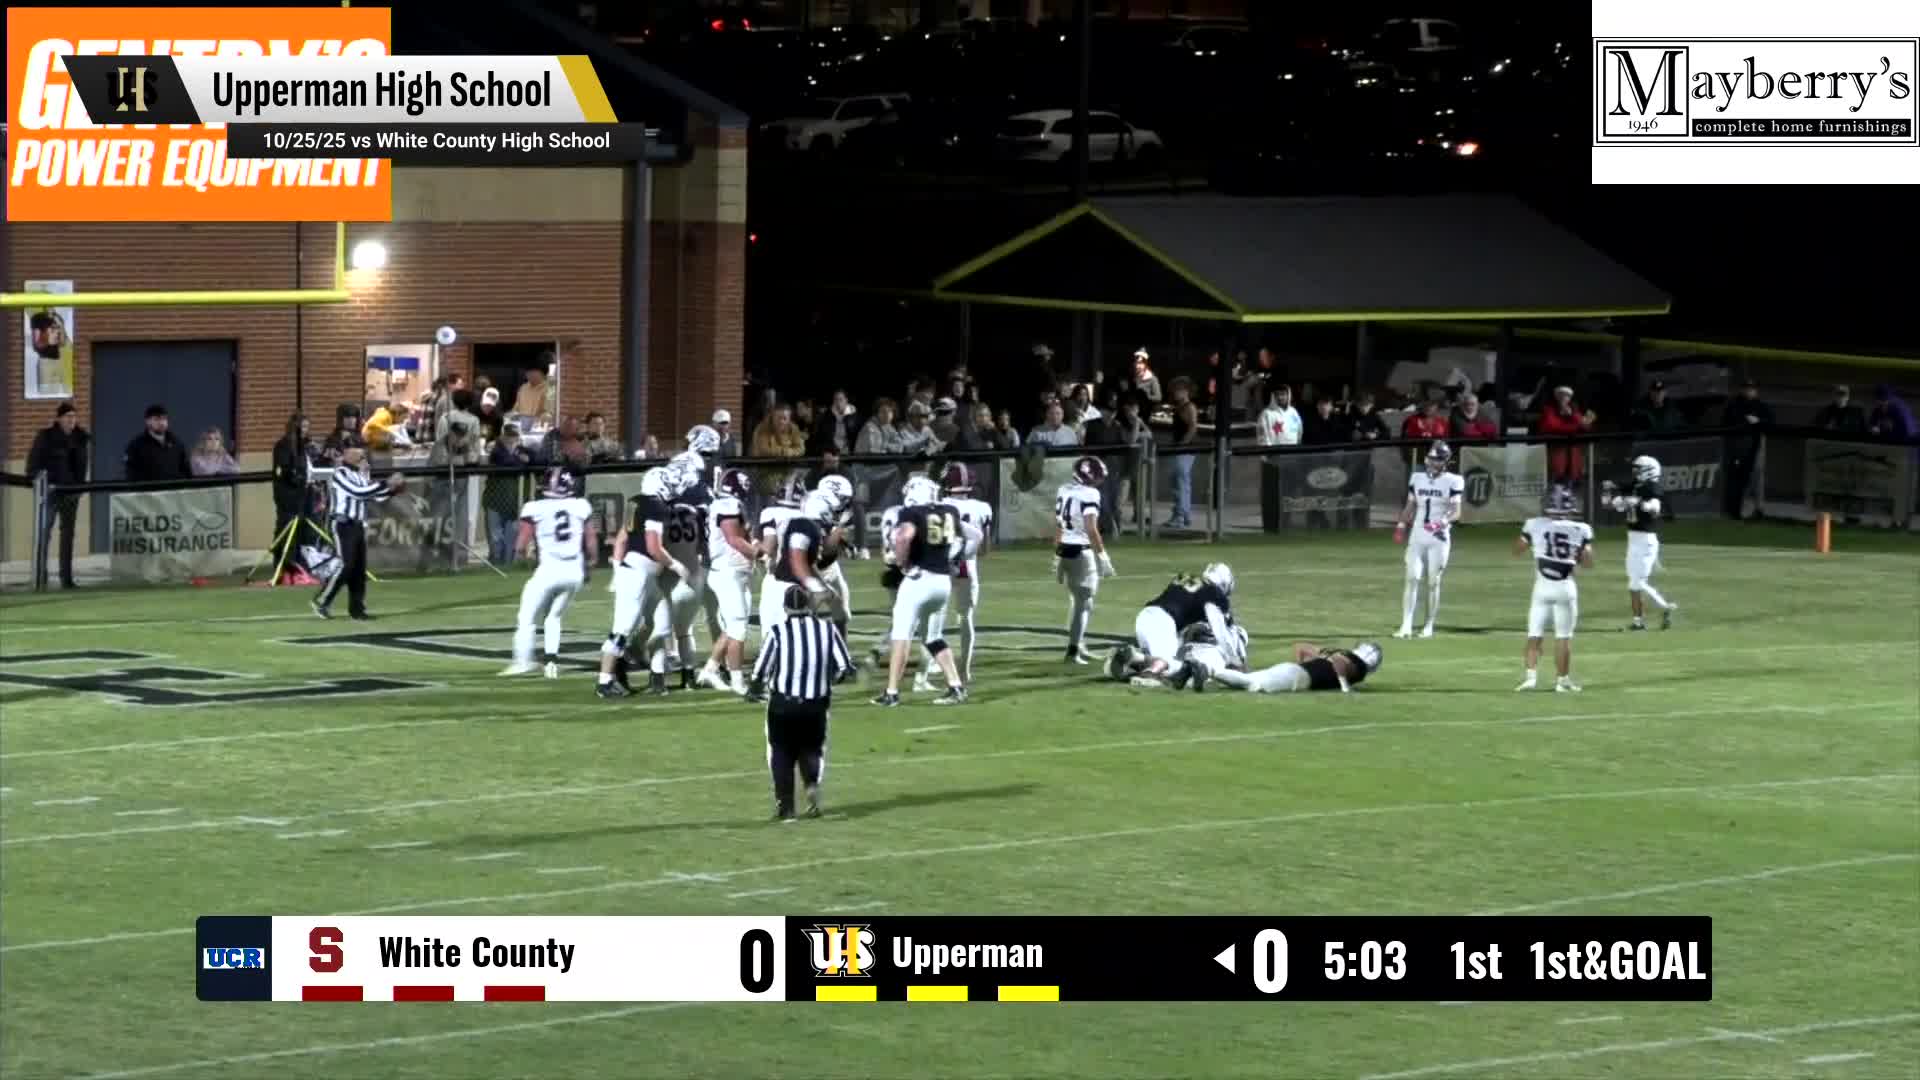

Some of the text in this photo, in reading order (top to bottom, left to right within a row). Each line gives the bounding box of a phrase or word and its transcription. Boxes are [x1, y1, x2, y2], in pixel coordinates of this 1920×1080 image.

[113, 513, 183, 534] FIELDS
[553, 509, 572, 542] 2
[113, 531, 231, 556] INSURANCE
[1543, 530, 1571, 559] 15
